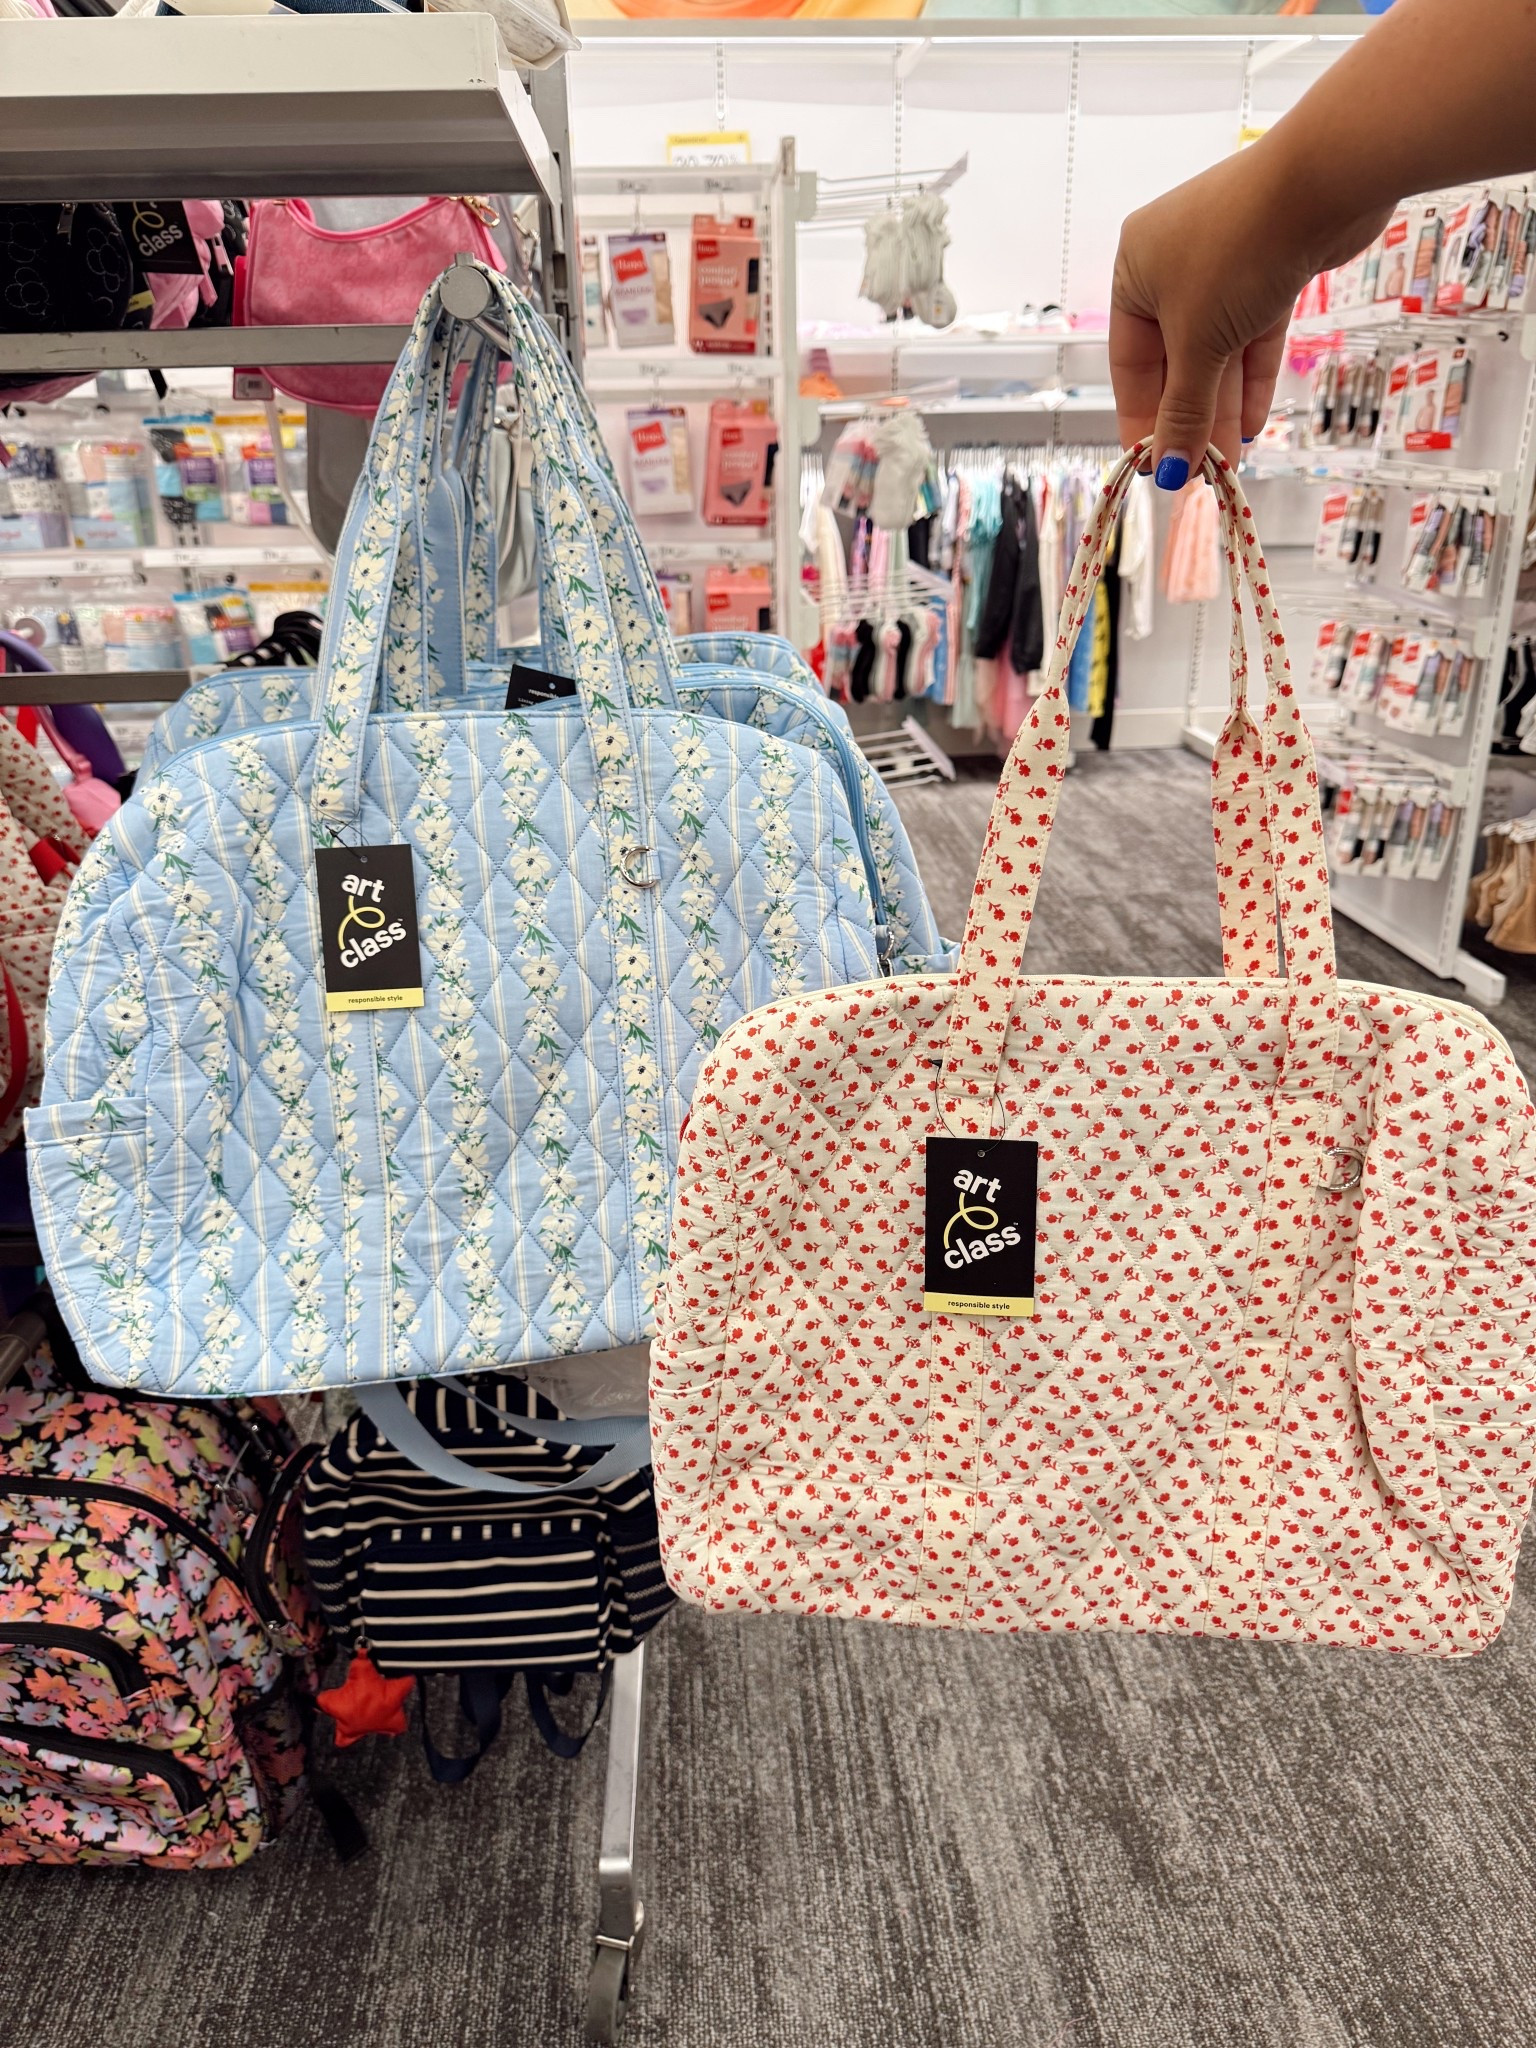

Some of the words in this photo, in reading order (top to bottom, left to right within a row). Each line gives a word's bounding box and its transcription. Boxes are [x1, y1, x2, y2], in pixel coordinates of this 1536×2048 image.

[138, 225, 184, 256] class
[341, 874, 385, 903] art
[340, 921, 407, 968] class
[348, 995, 386, 1004] responsible
[387, 995, 403, 1003] style
[953, 1168, 1002, 1203] art
[944, 1225, 1021, 1270] class
[948, 1300, 990, 1310] responsible
[992, 1303, 1010, 1311] style
